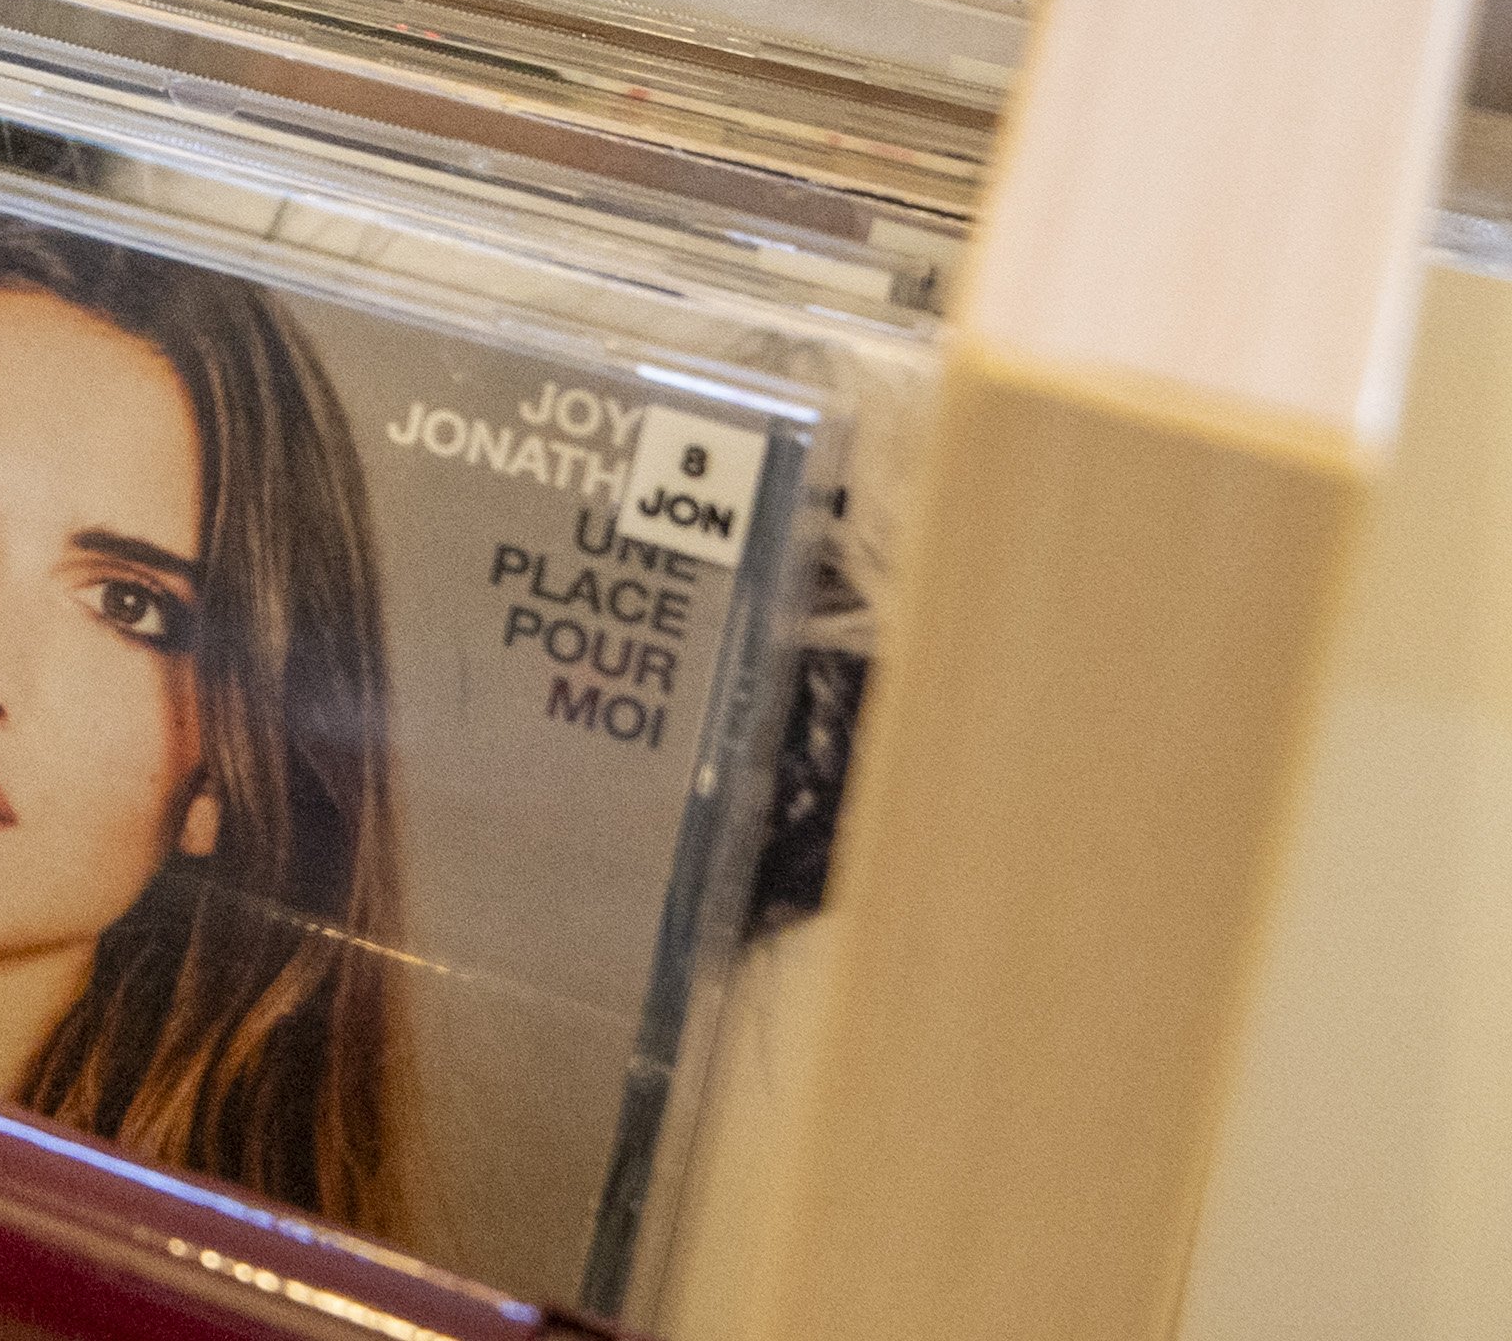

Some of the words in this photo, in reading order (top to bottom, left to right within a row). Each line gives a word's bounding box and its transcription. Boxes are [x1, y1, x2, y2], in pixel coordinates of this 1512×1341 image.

[519, 381, 644, 447] JOY
[386, 401, 628, 503] JONATH
[680, 445, 708, 479] 8
[638, 488, 735, 539] JON
[489, 543, 692, 640] PLACE
[502, 604, 679, 696] POUR
[545, 676, 668, 751] MOI
